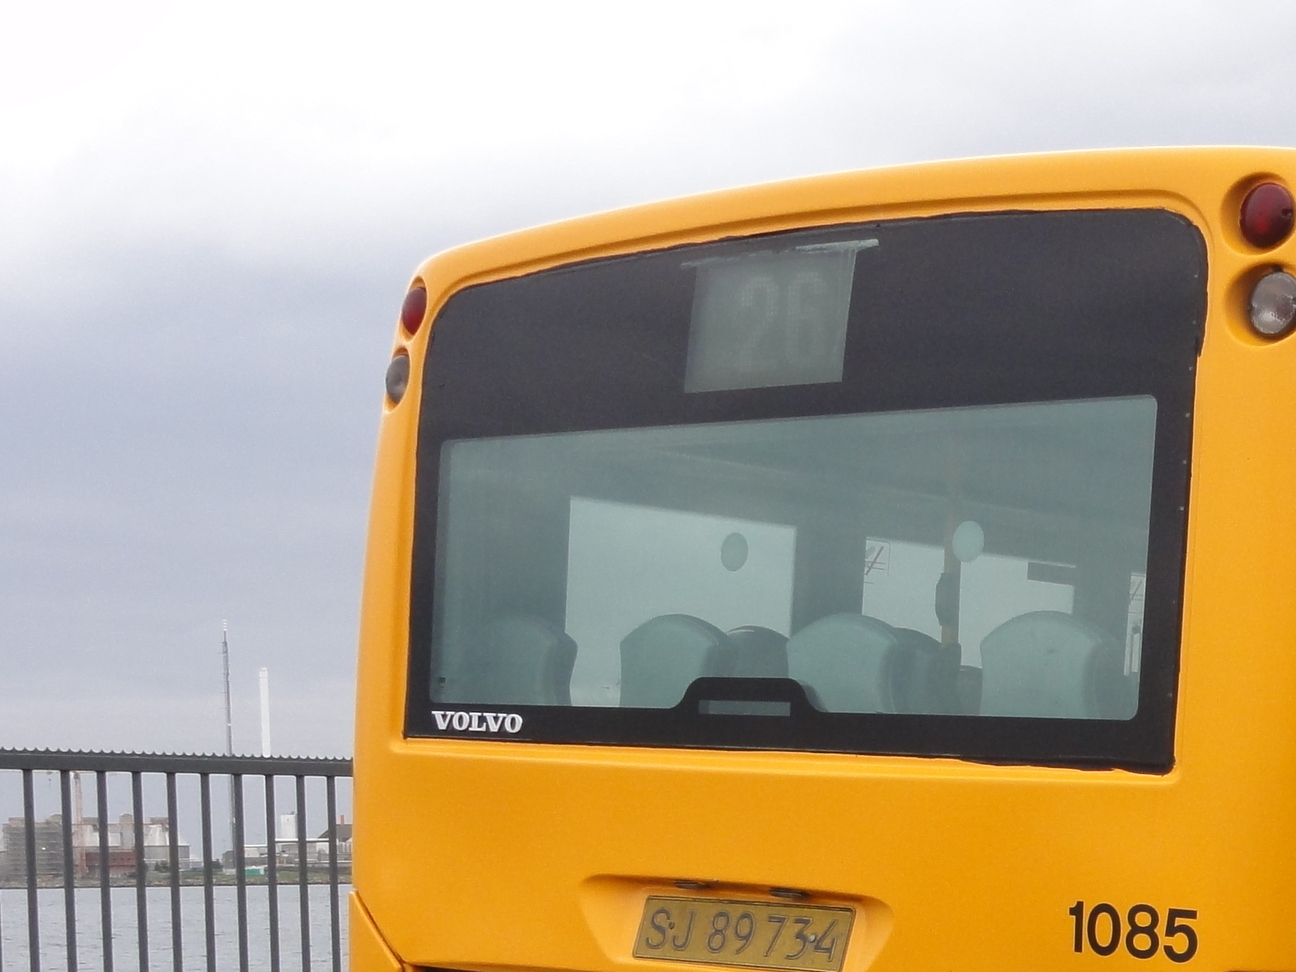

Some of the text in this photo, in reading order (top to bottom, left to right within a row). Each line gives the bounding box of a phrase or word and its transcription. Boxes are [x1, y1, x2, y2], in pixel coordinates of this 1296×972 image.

[431, 710, 523, 733] VOLVO
[645, 907, 840, 963] SJ 89 734
[1068, 900, 1199, 964] 1085
